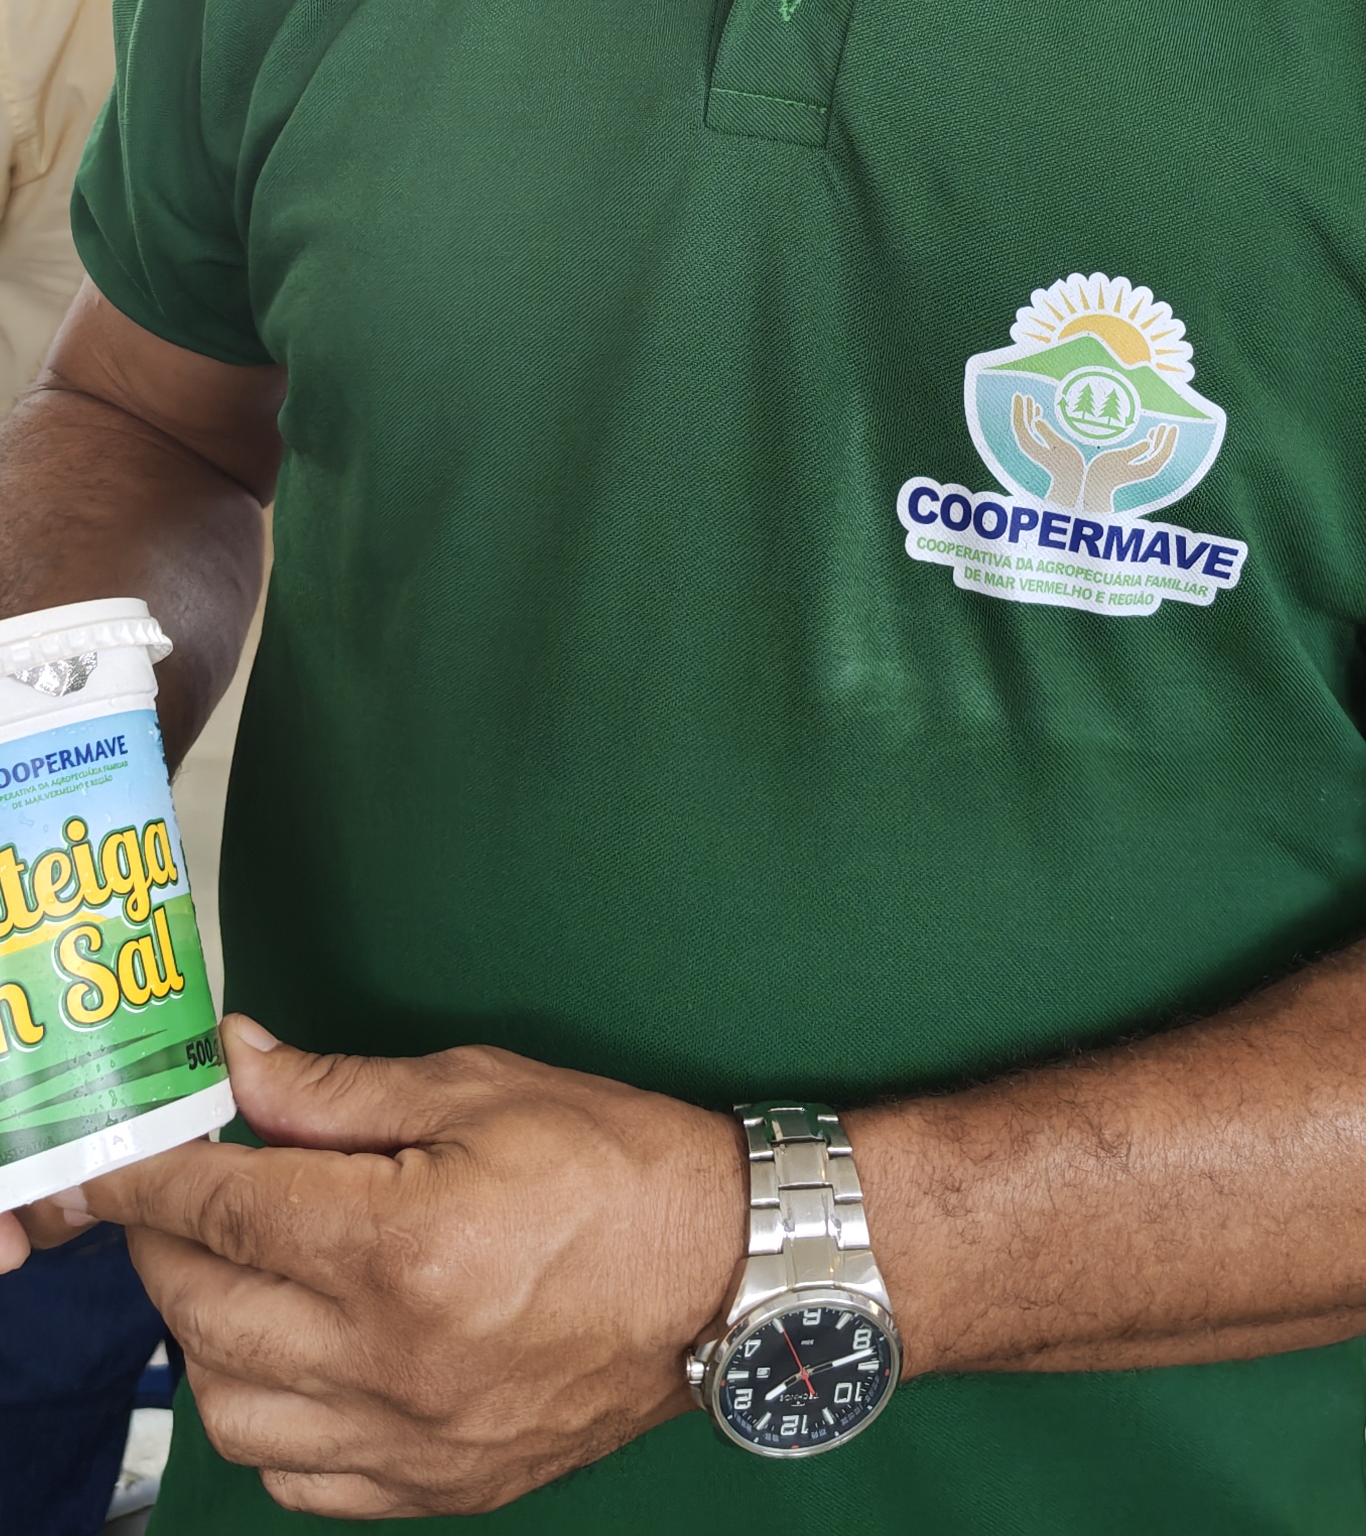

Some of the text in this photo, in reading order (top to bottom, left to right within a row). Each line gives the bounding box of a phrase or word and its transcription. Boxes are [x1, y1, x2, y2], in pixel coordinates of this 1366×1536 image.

[908, 486, 1239, 581] COOPERMAVE
[916, 536, 1211, 599] COOPERATIVA DA AGROPECUÁRIA FAMILIAR
[964, 566, 1155, 607] DE MAR VERMELHO E REGIÃO
[37, 781, 50, 791] DA
[51, 766, 103, 787] AGROPECUÁRIA
[11, 800, 23, 810] DE
[24, 794, 44, 807] MAR
[44, 782, 85, 801] VERMELHO
[53, 906, 185, 1031] Sal
[744, 1339, 762, 1358] 4
[852, 1328, 872, 1351] 8
[734, 1388, 753, 1410] 2
[833, 1381, 863, 1404] 10
[780, 1414, 809, 1436] 12
